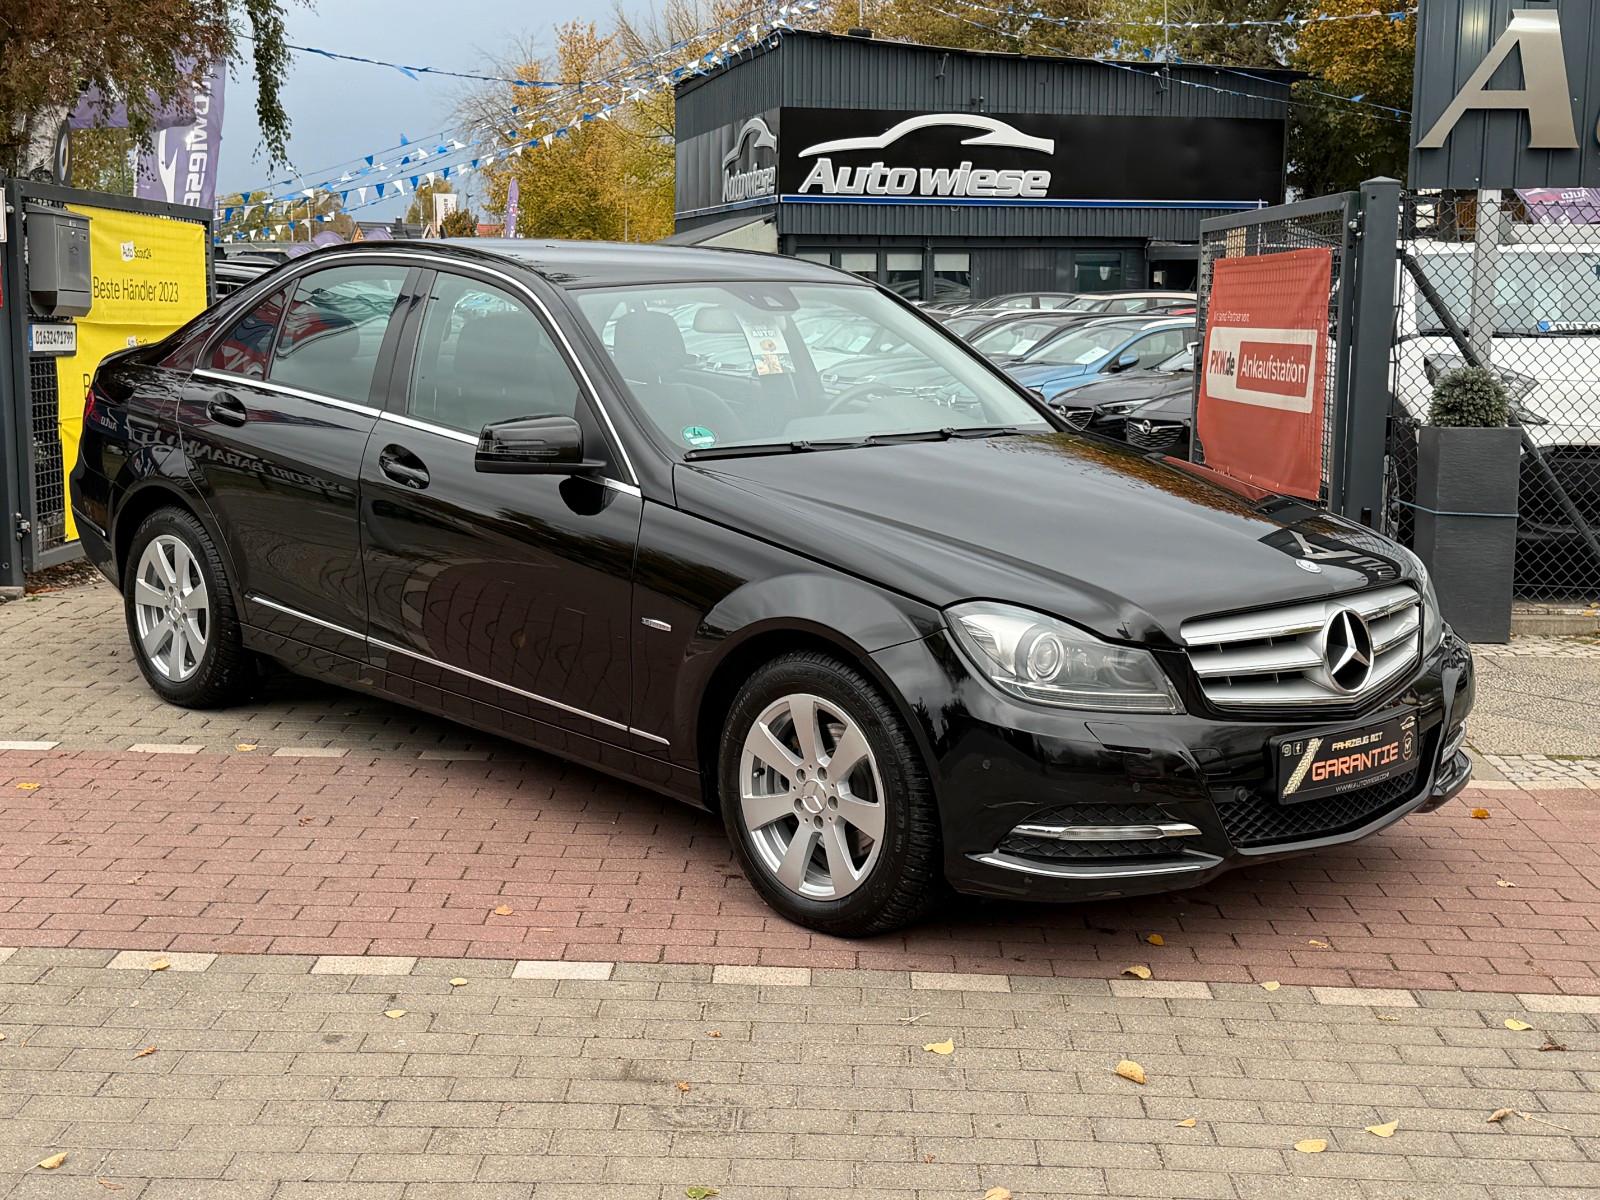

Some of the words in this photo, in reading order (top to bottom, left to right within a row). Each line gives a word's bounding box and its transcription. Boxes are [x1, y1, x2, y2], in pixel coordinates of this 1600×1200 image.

[1415, 8, 1600, 149] A
[722, 163, 776, 203] Autowiese
[798, 157, 1052, 198] Autowiese
[92, 276, 120, 300] Beste
[122, 278, 157, 302] Händler
[158, 281, 179, 303] 2023
[1209, 349, 1235, 377] PKW.de
[1240, 353, 1306, 384] Ankaufstation
[1311, 741, 1399, 781] GARANTIE
[1331, 735, 1369, 752] FAHRZEUG
